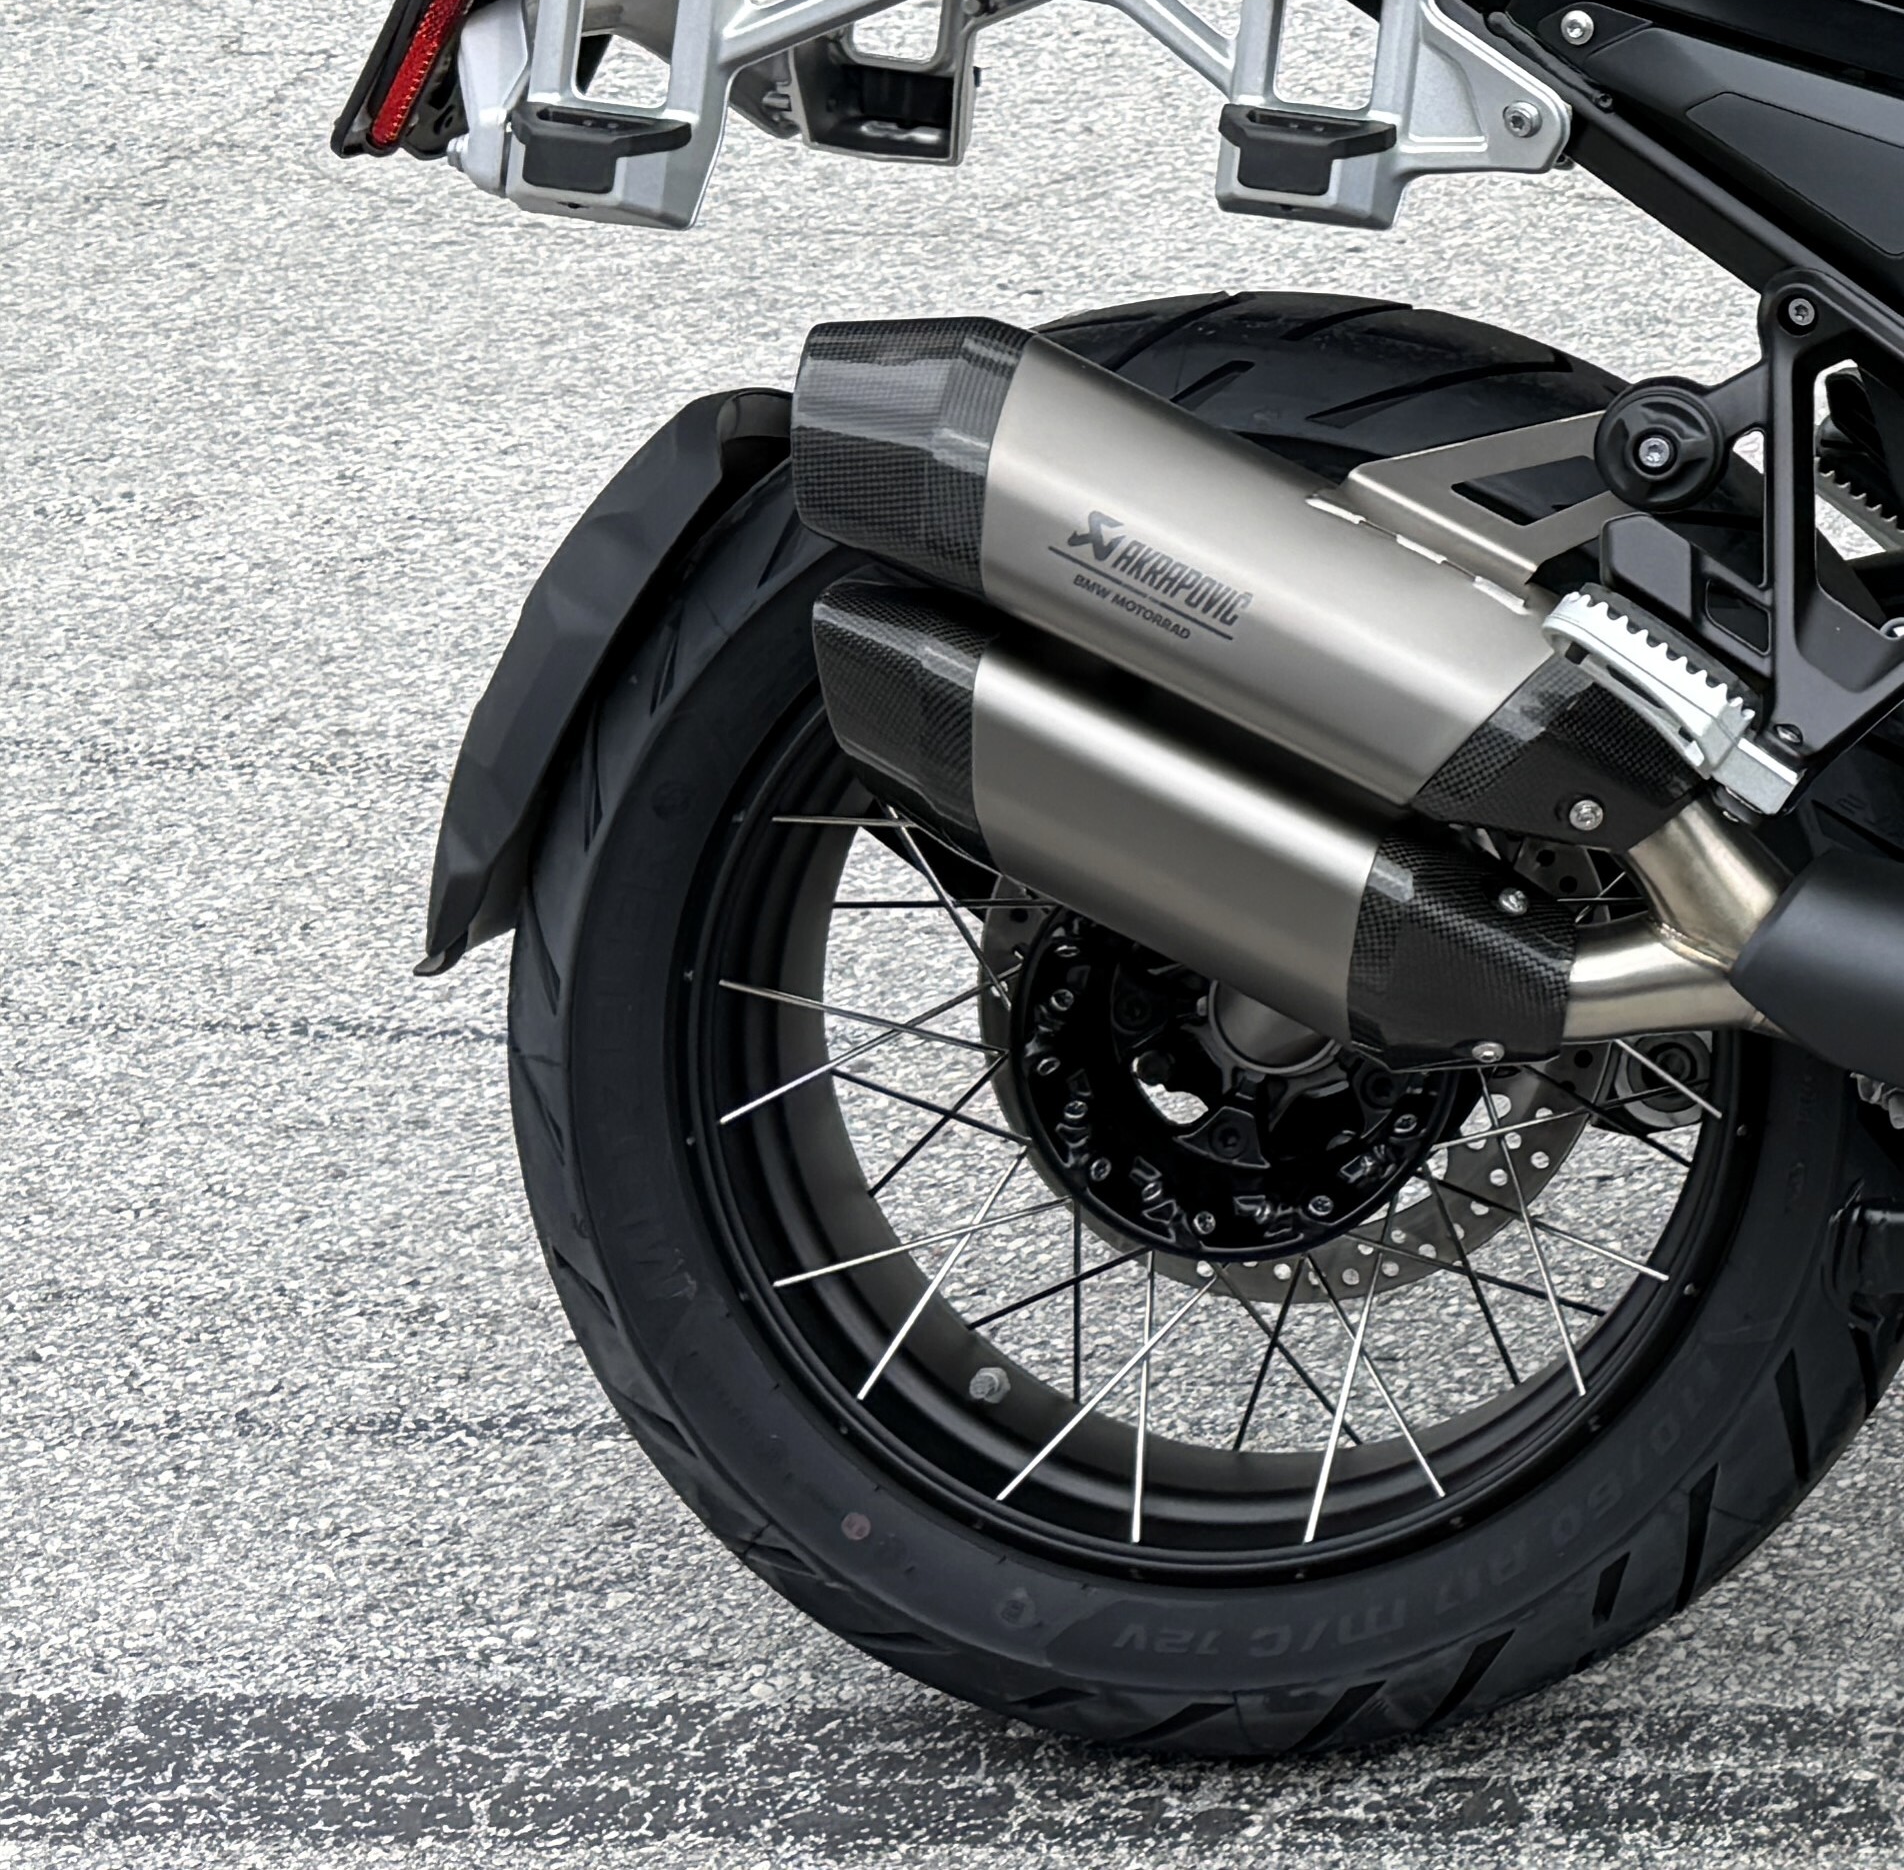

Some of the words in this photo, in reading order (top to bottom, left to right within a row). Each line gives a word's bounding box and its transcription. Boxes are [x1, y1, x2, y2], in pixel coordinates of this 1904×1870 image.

[1073, 573, 1111, 605] BMW
[1110, 592, 1192, 641] MOTORRAD
[1433, 1537, 1531, 1610] R17
[1112, 1625, 1225, 1657] 72V
[1249, 1597, 1409, 1656] M/C
